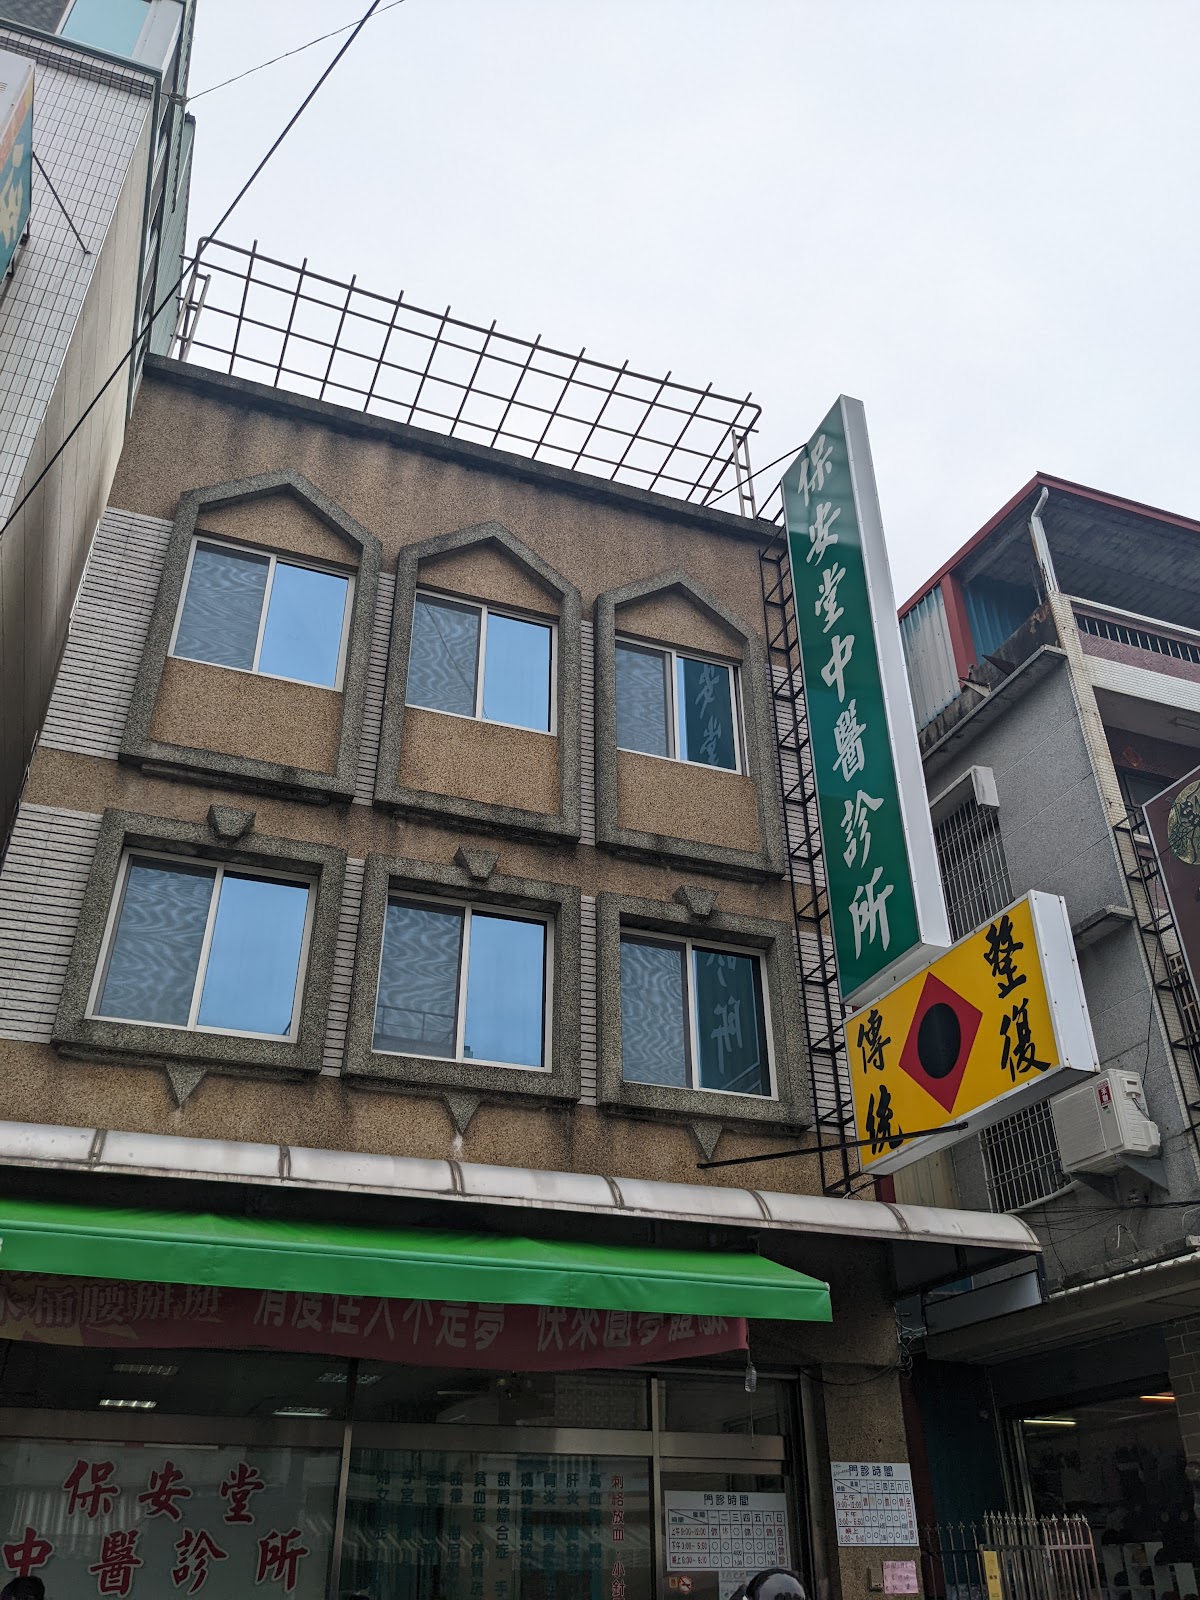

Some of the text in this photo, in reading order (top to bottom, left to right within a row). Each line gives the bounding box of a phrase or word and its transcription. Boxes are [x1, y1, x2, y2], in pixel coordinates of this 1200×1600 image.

[797, 432, 895, 960] 保安堂中醫診所
[983, 914, 1052, 1083] 整復
[855, 1008, 903, 1156] 傳統
[848, 1464, 894, 1477] 門診時間
[63, 1458, 266, 1525] 保安堂
[703, 1494, 749, 1506] 門診時間
[732, 1514, 740, 1522] 三
[743, 1514, 751, 1522] 四
[754, 1514, 761, 1522] 五
[765, 1514, 772, 1522] 六
[776, 1514, 783, 1522] 日
[2, 1527, 310, 1597] 中醫診所
